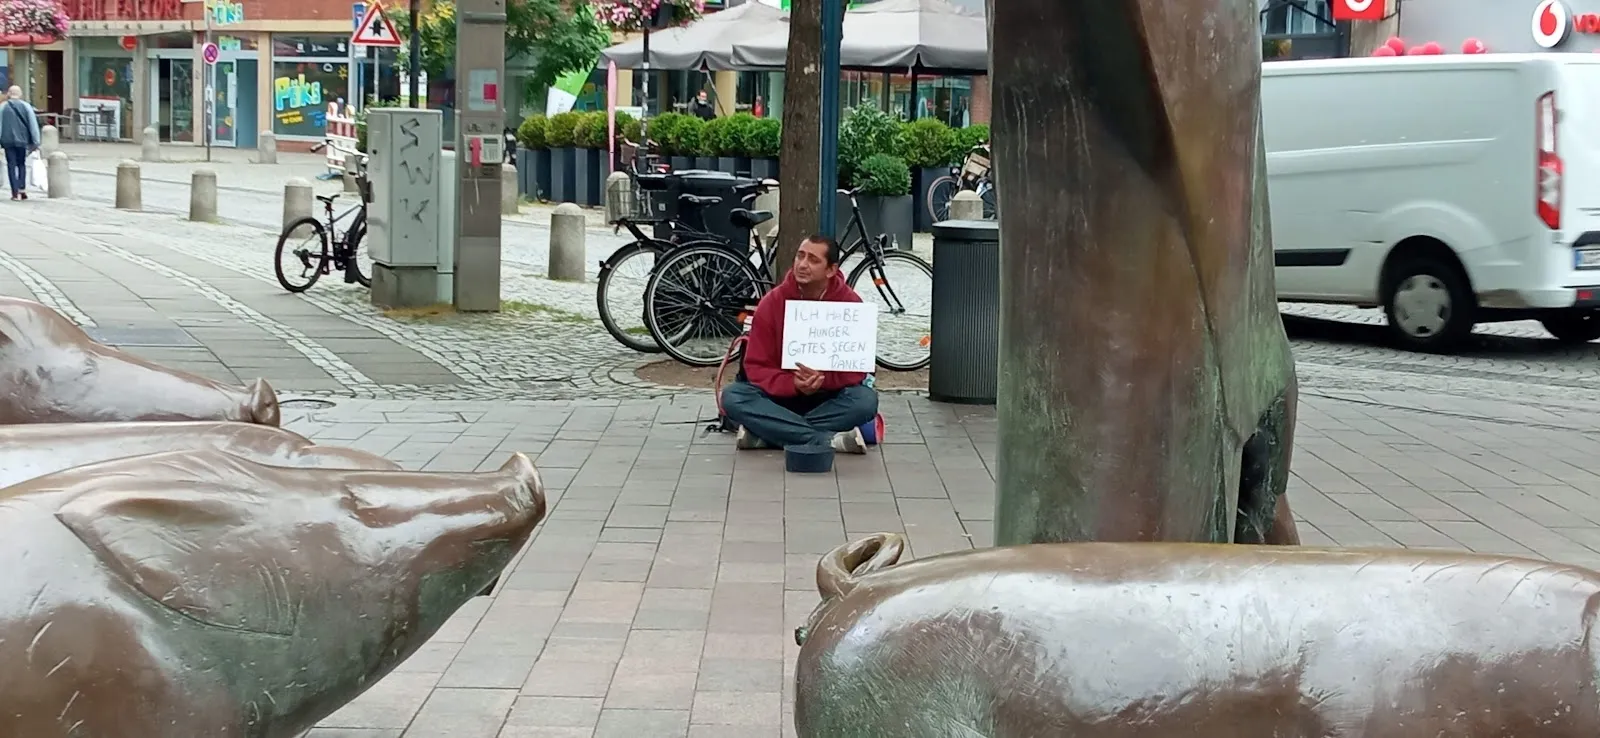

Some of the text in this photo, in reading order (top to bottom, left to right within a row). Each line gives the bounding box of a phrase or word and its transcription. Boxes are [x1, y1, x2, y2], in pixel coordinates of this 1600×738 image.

[794, 308, 819, 322] ICH
[808, 326, 850, 339] HUNGER
[828, 354, 867, 370] DANKE
